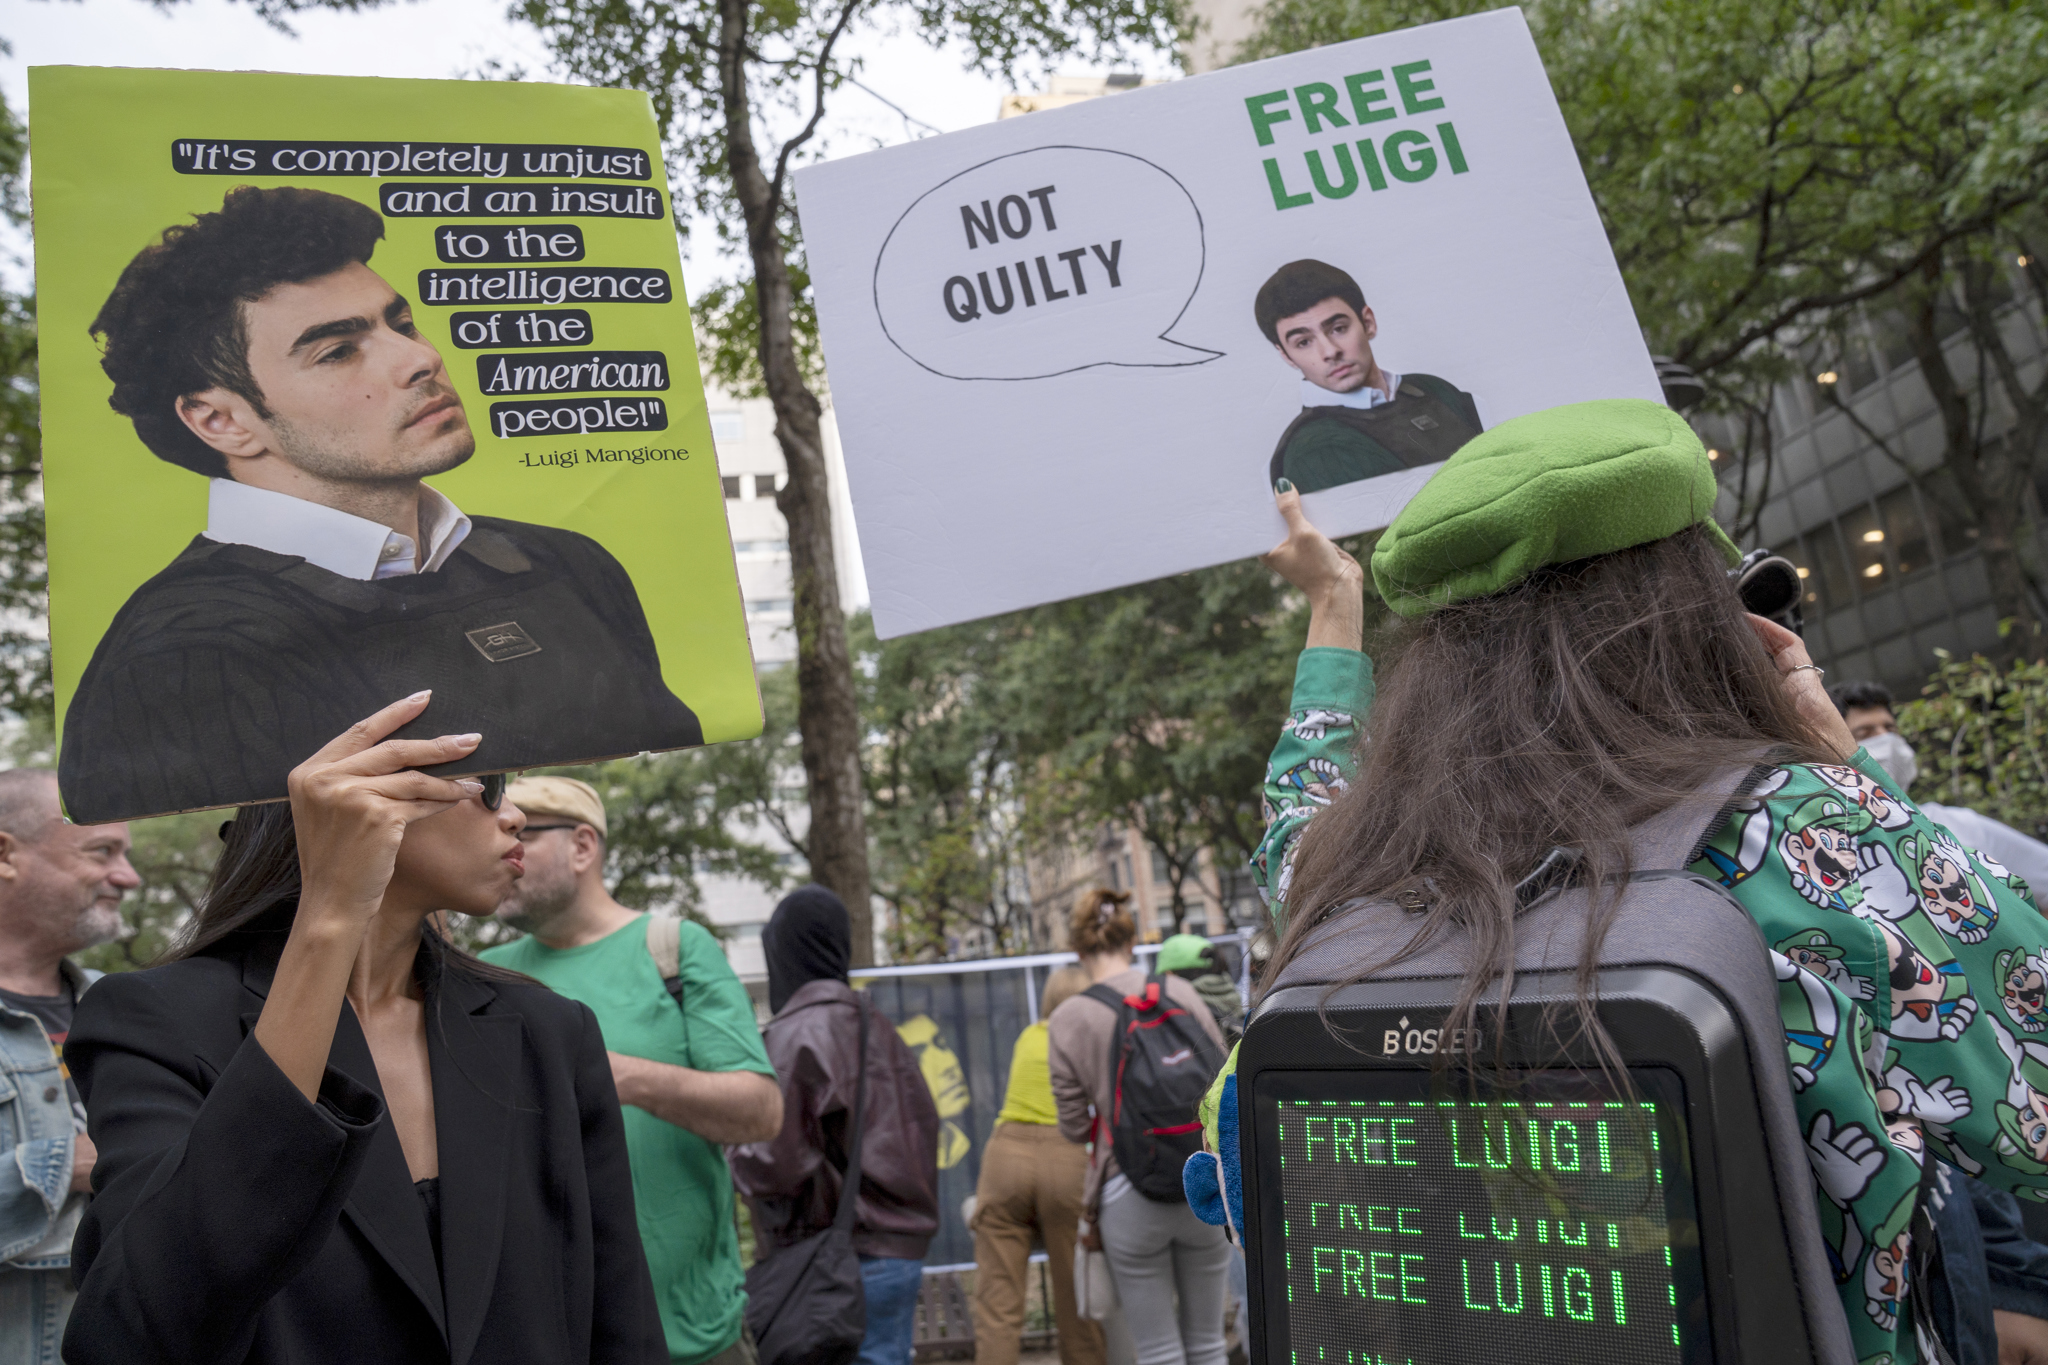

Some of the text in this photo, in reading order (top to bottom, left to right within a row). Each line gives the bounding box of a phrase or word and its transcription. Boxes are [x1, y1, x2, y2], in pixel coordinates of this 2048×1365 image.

[1244, 59, 1446, 147] FREE
[179, 143, 644, 178] "It's completely unjust
[1262, 121, 1470, 211] LUIGI
[386, 185, 657, 215] and an insult
[960, 185, 1057, 250] NOT
[442, 228, 578, 258] to the
[427, 270, 665, 305] intelligence
[943, 239, 1123, 323] QUILTY
[458, 312, 587, 344] of the
[486, 357, 664, 393] American
[497, 400, 661, 440] people!"
[518, 446, 690, 469] -Luigi Mangione
[1306, 1116, 1612, 1172] FREE LUIGI
[1313, 1246, 1627, 1325] FREE LUIGI
